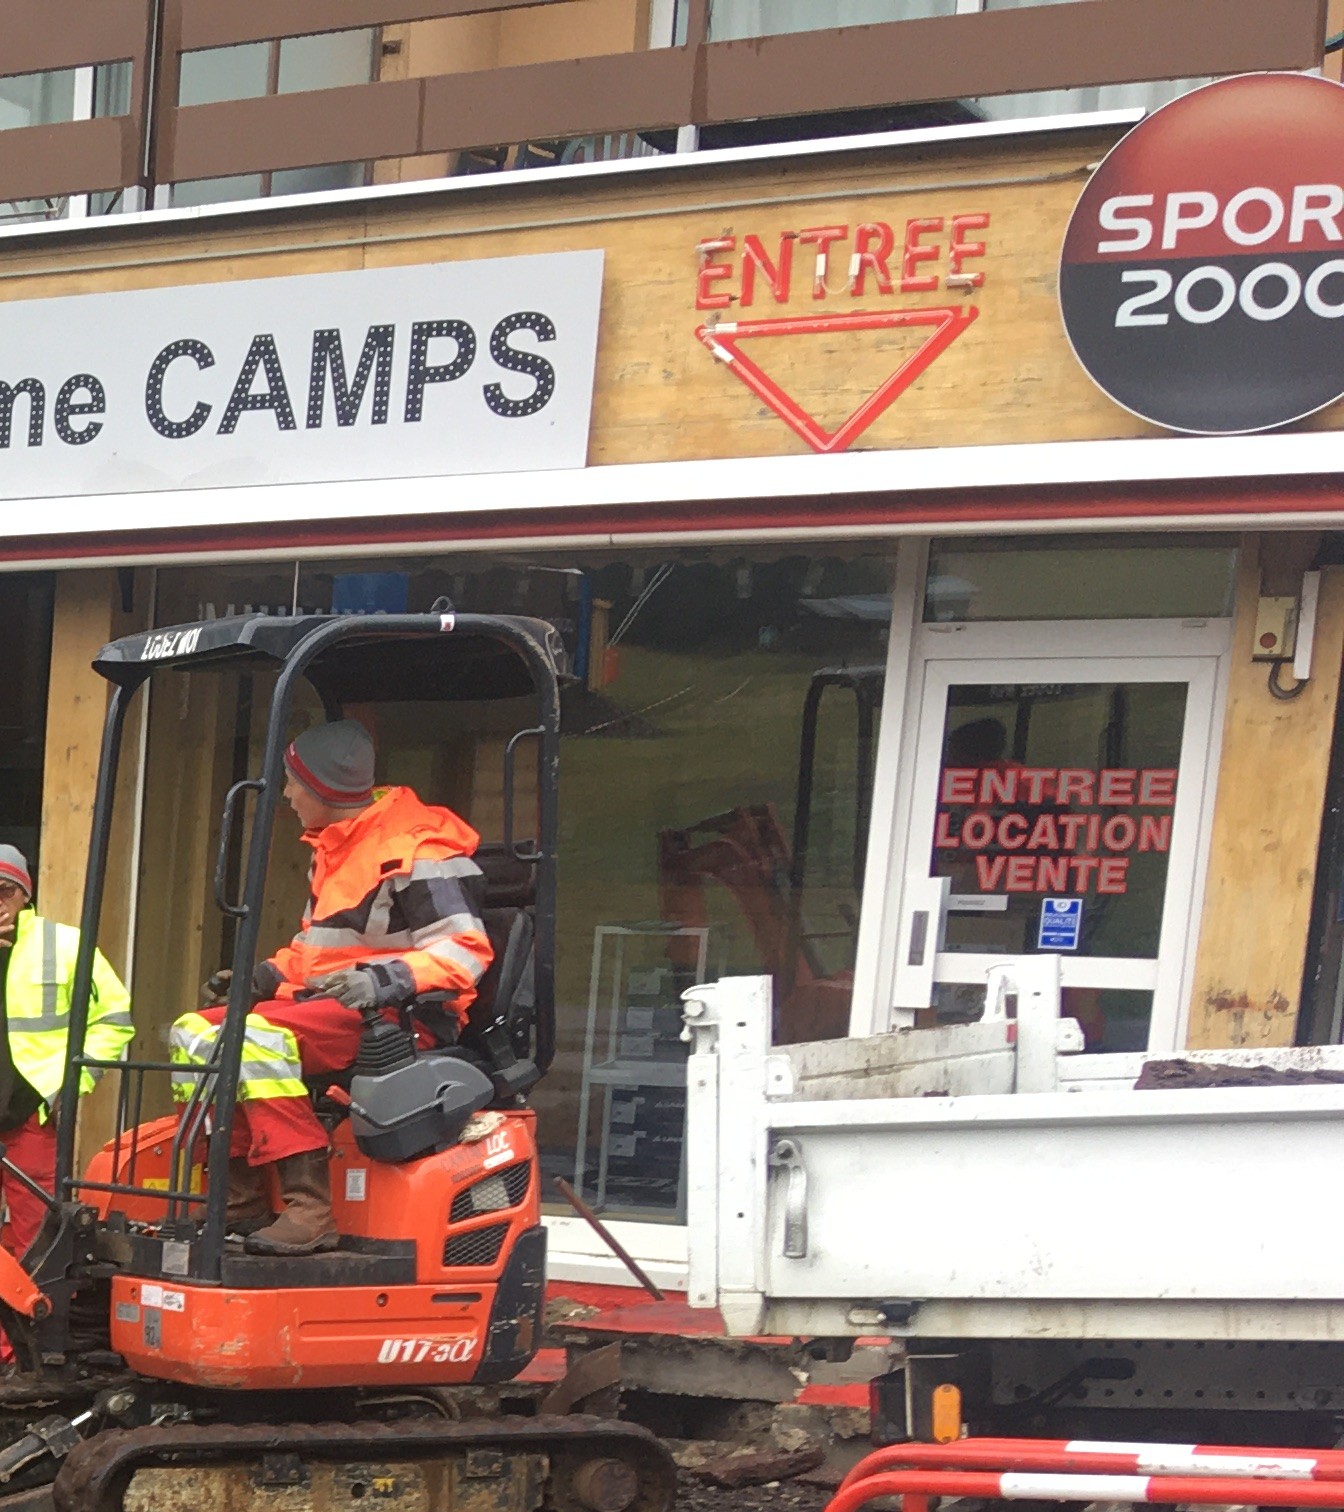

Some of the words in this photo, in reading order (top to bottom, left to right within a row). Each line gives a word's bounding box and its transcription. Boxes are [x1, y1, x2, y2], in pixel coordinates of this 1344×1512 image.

[695, 212, 991, 311] ENTREE
[1115, 261, 1344, 328] 2000
[144, 310, 558, 440] CAMPS
[941, 768, 1179, 806] ENTREE
[935, 814, 1172, 852] LOCATION
[976, 855, 1130, 894] VENTE
[485, 1131, 511, 1155] LOC
